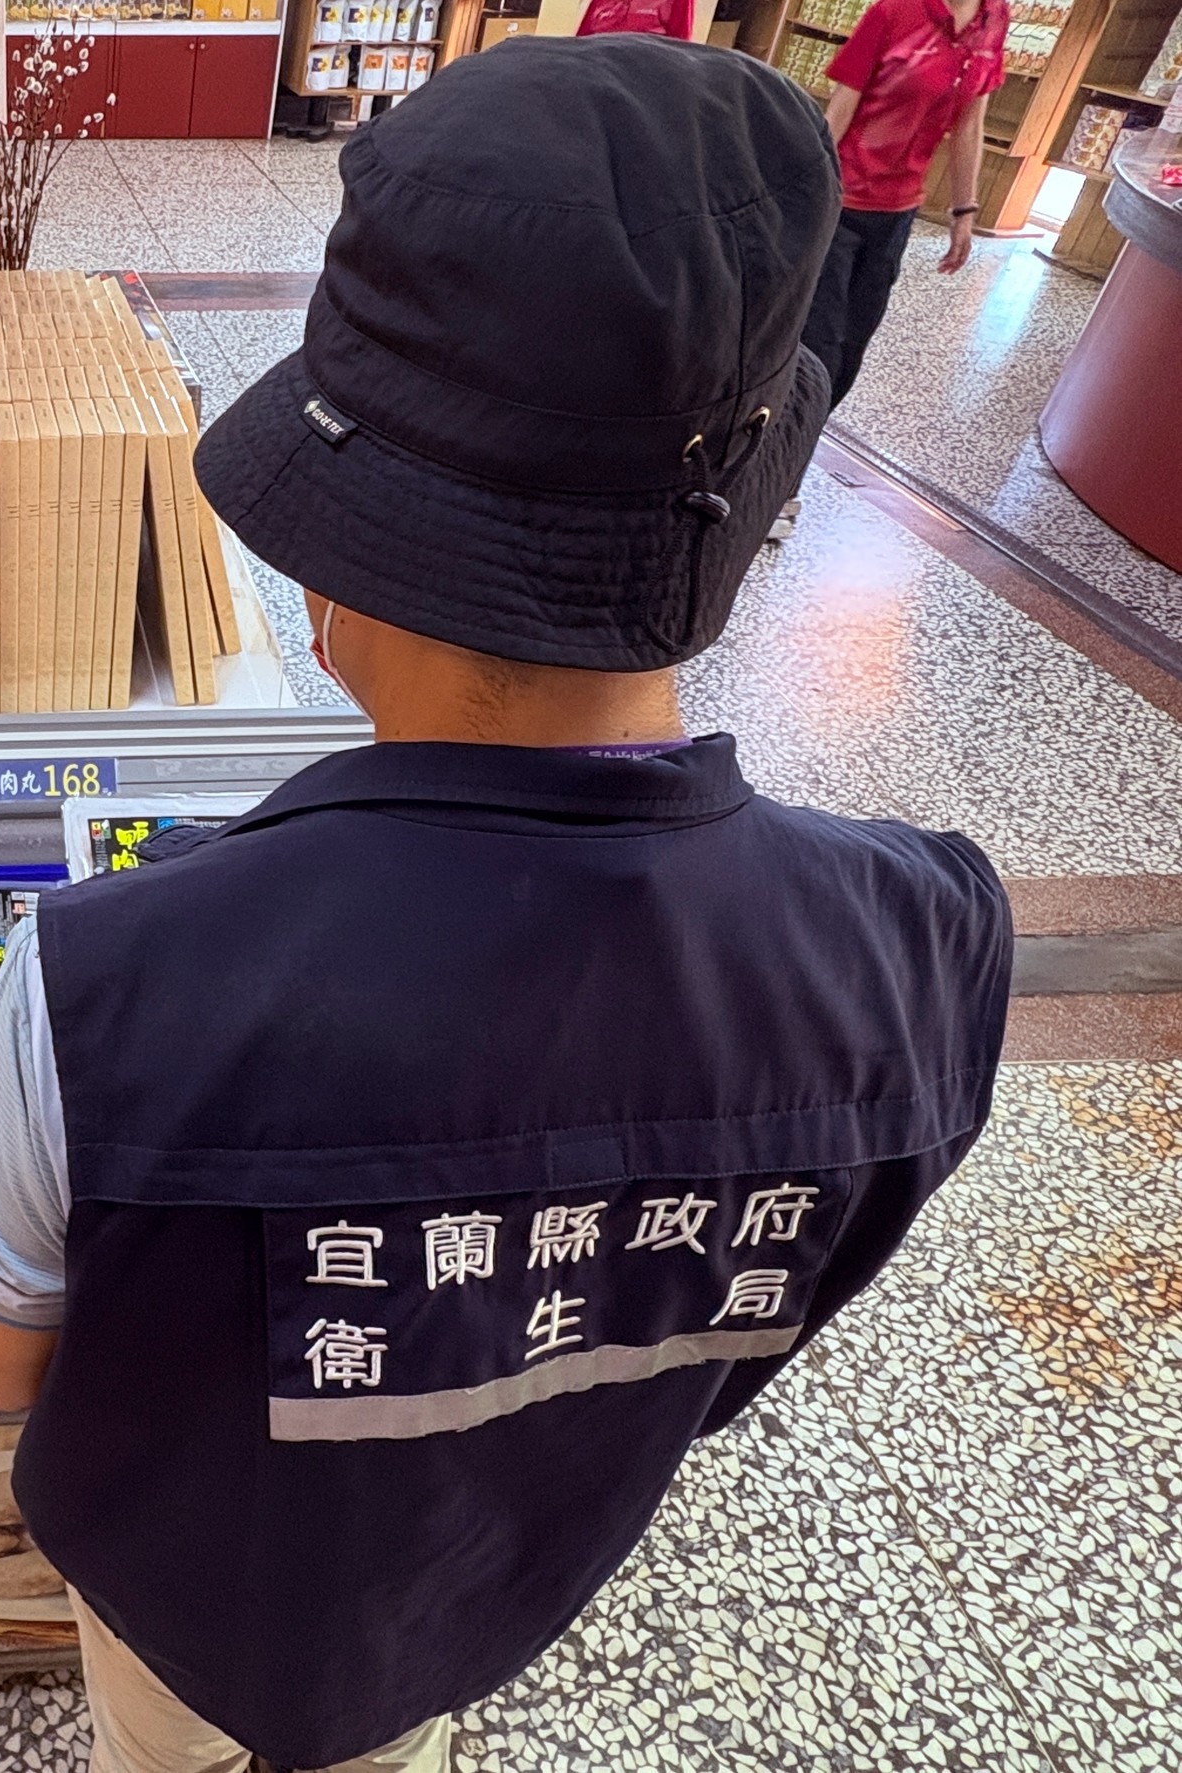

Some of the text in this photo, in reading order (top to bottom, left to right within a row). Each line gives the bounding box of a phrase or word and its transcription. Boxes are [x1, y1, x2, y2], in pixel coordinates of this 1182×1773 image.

[43, 763, 101, 797] 168
[305, 1182, 820, 1290] 宜蘭縣政府
[304, 1268, 789, 1389] 衛生局
